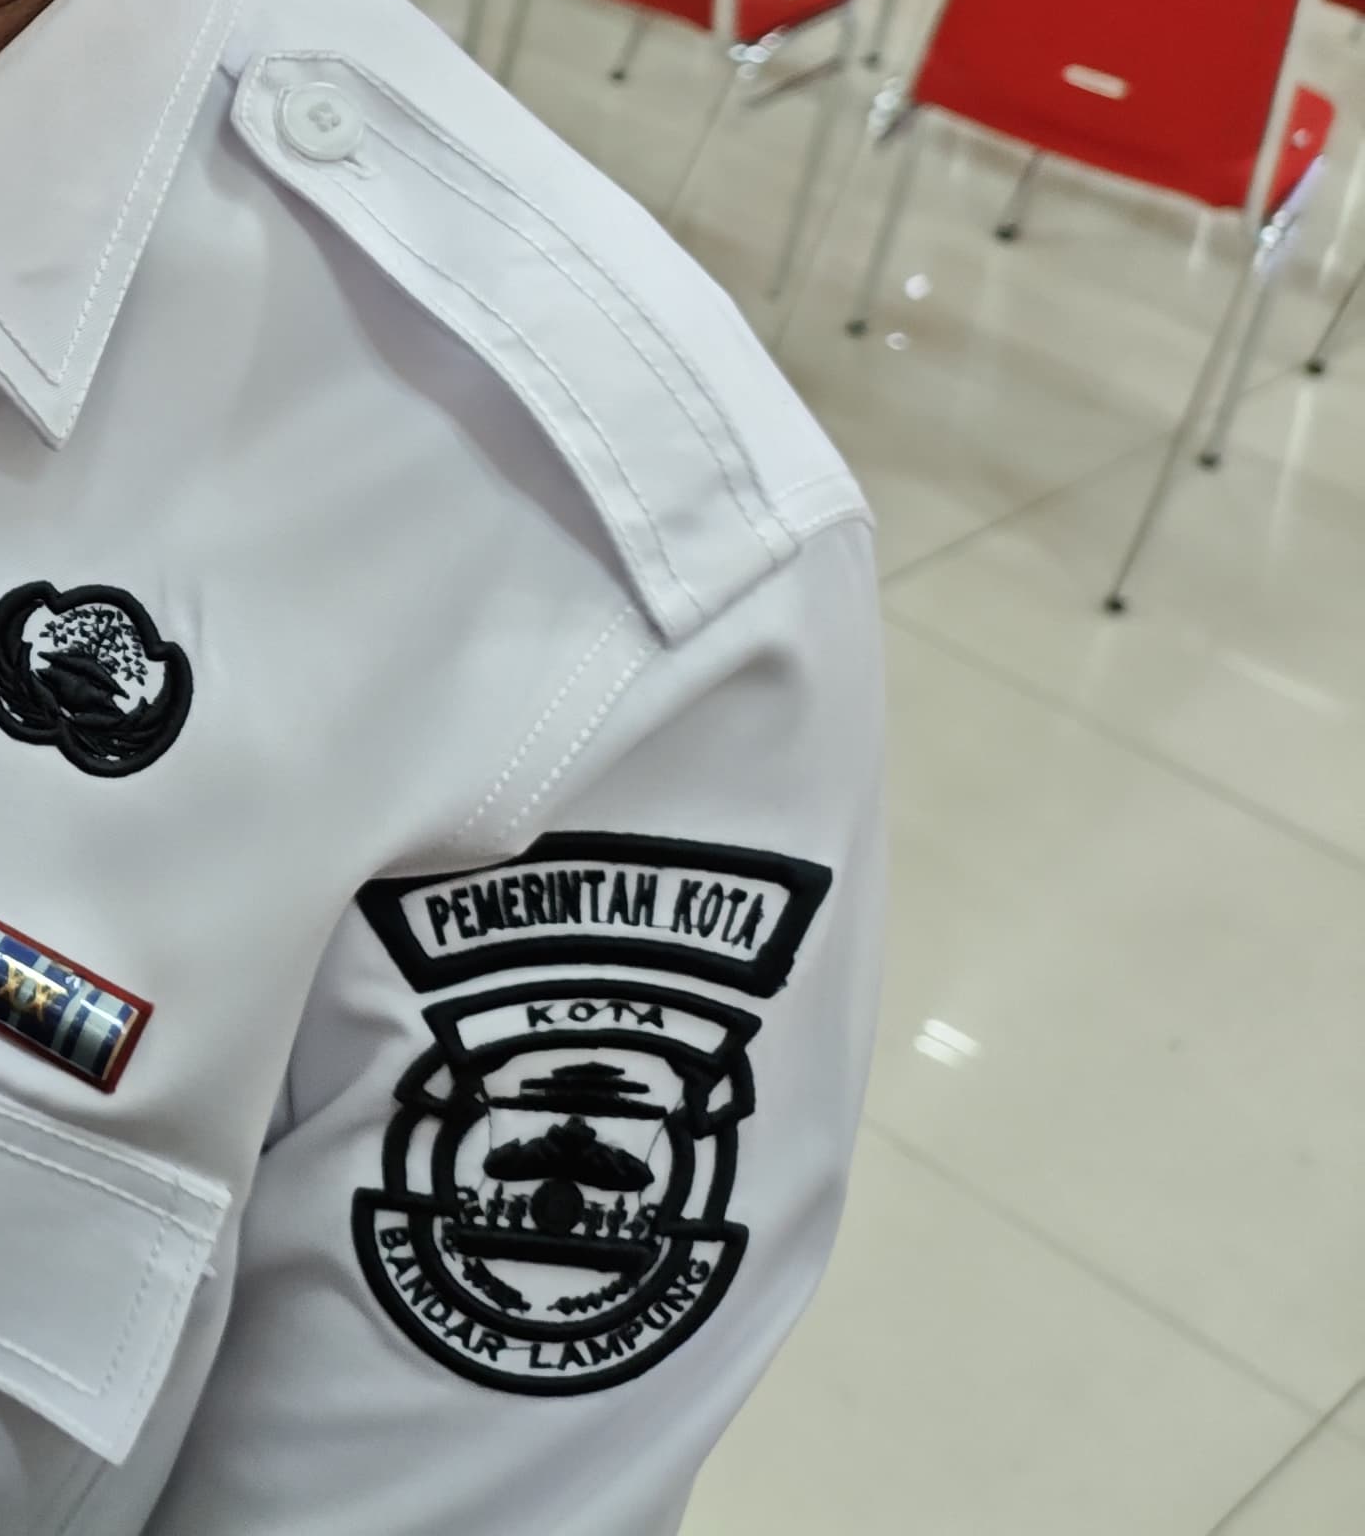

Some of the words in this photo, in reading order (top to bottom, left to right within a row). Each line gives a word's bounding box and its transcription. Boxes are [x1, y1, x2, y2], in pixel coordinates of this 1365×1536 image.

[425, 868, 659, 948] PEMERINTAH
[671, 877, 766, 952] KOTA
[526, 1000, 666, 1030] KOTA
[377, 1225, 511, 1362] BANDAR
[528, 1258, 712, 1372] LAMPUNG
